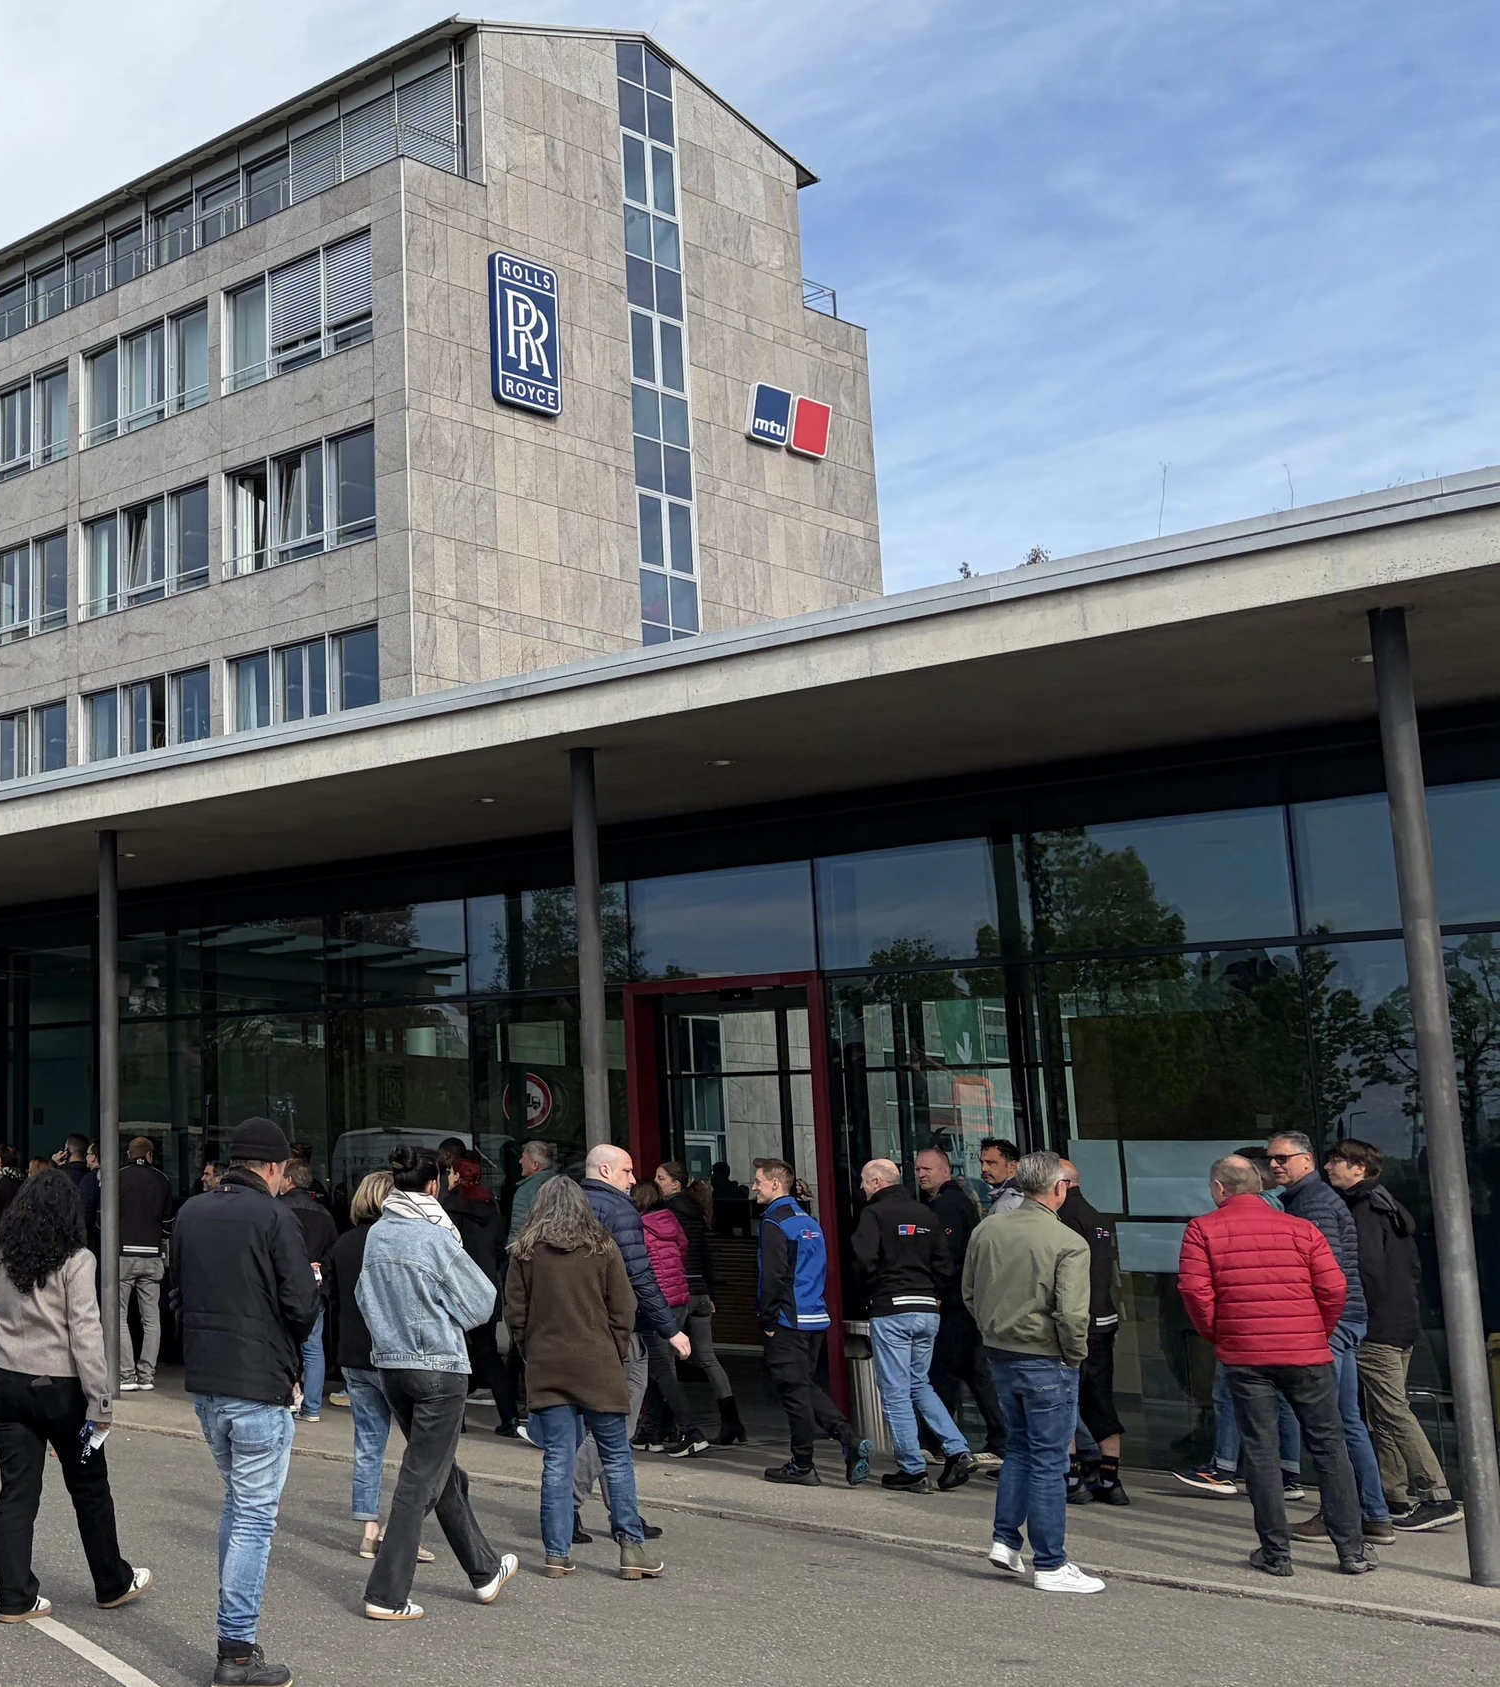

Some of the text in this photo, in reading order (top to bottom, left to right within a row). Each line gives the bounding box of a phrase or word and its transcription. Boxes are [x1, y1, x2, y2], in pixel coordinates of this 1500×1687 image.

[502, 260, 551, 290] ROLLS
[505, 288, 553, 380] RR
[505, 378, 556, 407] ROYCE
[754, 417, 786, 437] mtu
